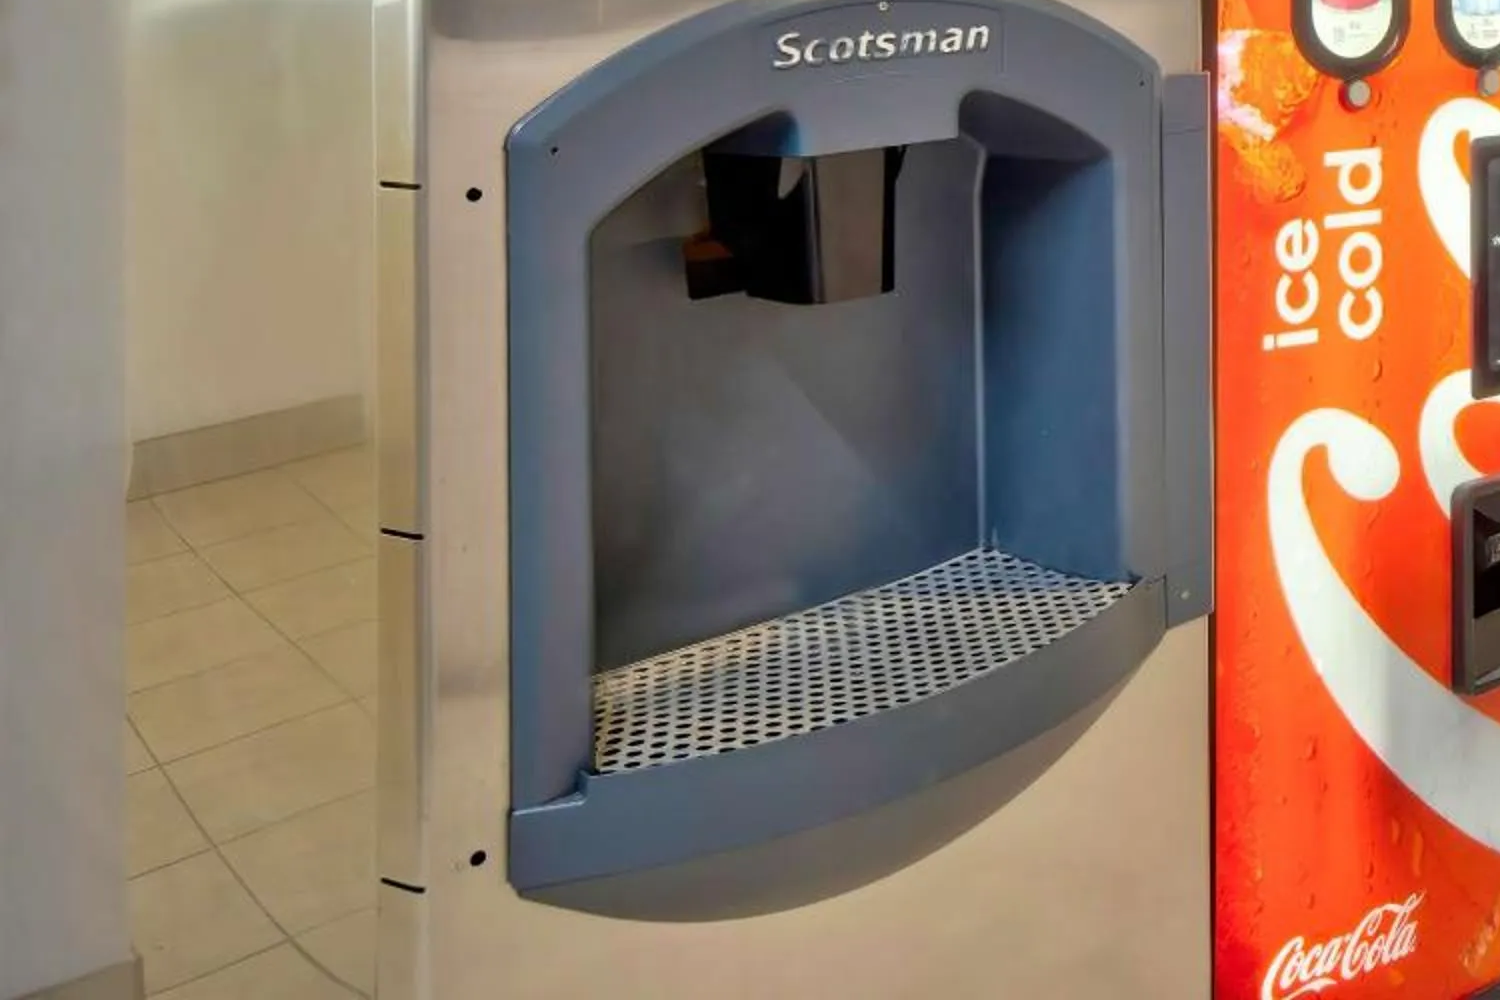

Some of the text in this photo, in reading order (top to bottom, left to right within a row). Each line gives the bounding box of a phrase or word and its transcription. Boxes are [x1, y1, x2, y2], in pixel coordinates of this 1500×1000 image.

[772, 24, 990, 69] Scotsman
[1262, 218, 1320, 351] ice
[1323, 147, 1384, 341] cold
